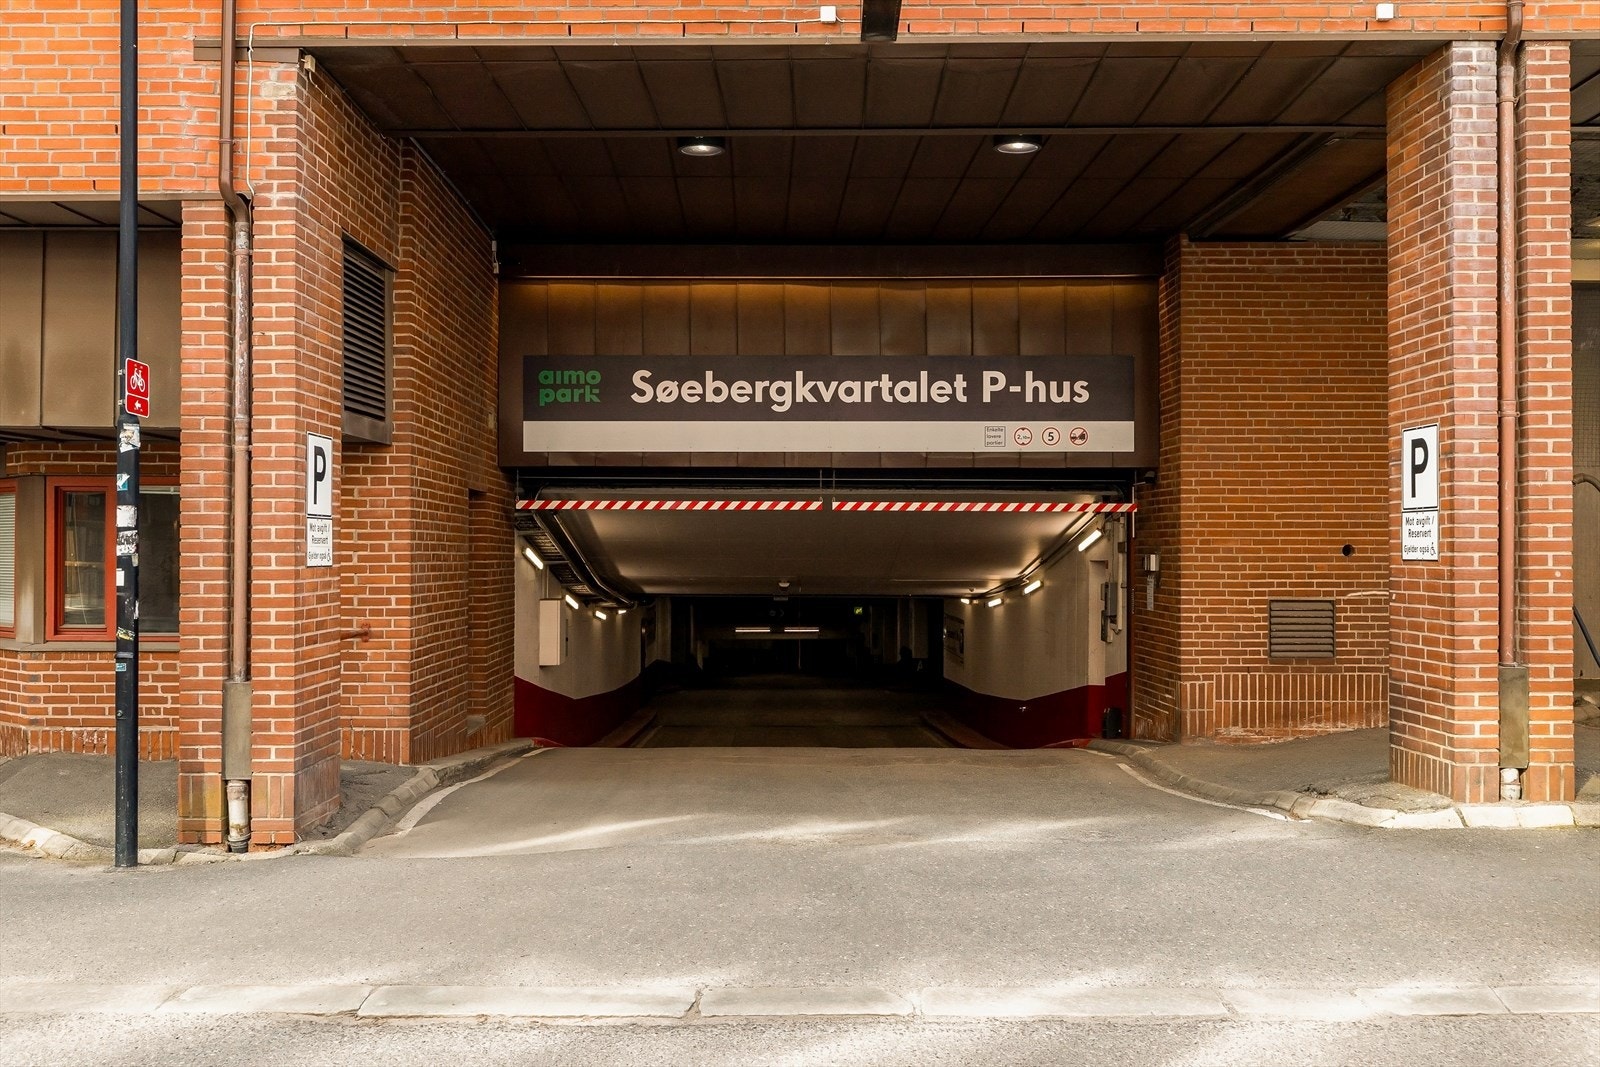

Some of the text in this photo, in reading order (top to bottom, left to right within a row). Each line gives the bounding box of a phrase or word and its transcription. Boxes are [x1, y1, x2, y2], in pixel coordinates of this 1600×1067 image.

[539, 387, 601, 406] park
[630, 369, 1090, 413] Søebergkvartalet P-hus
[1047, 431, 1055, 442] 5
[1411, 437, 1429, 498] P
[313, 445, 326, 505] P
[1405, 516, 1414, 526] Mot
[1415, 515, 1431, 528] avgift
[309, 522, 317, 533] Mot
[317, 524, 328, 535] avgift
[1408, 528, 1432, 538] Reservert
[311, 534, 329, 545] Reservert
[1403, 544, 1430, 555] Gjelder også
